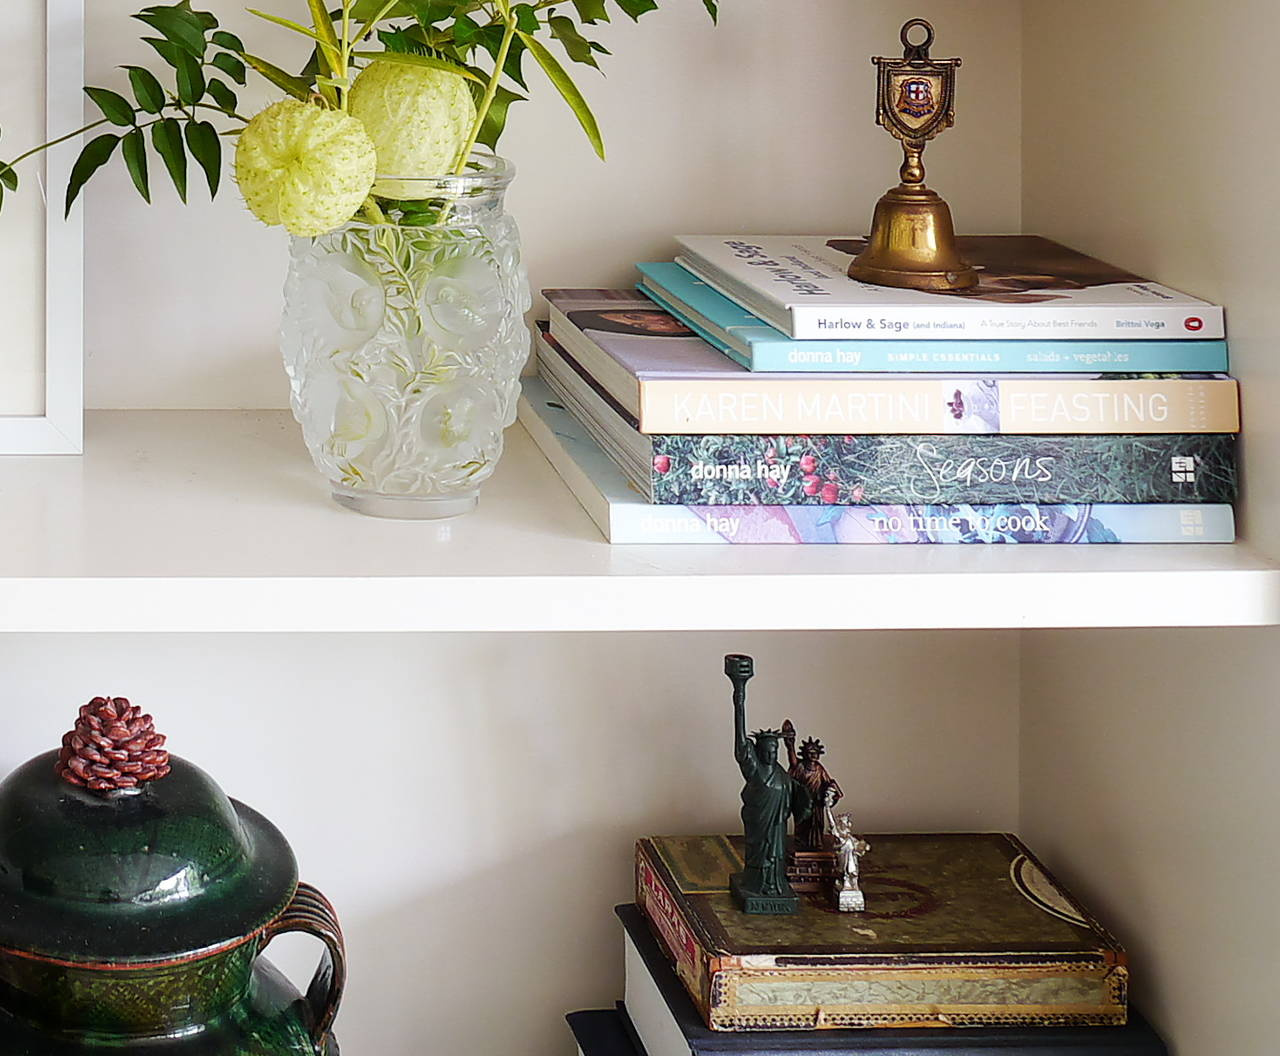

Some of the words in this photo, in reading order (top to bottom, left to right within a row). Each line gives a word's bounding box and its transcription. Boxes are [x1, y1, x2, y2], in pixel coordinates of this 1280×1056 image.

[817, 318, 861, 330] Harlow
[866, 319, 876, 330] &
[879, 319, 910, 332] Sage
[932, 320, 966, 331] Indiana)
[788, 348, 833, 364] donna
[836, 348, 862, 366] hay
[673, 392, 784, 422] KAREN
[799, 392, 930, 422] MARTINI
[1009, 392, 1169, 422] FEASTING
[690, 461, 752, 480] donna
[756, 459, 792, 485] hay
[910, 442, 1056, 500] Seasons
[640, 515, 703, 532] donna
[705, 513, 741, 536] hay
[870, 516, 902, 532] no
[908, 511, 962, 532] time
[968, 514, 990, 532] to
[995, 513, 1050, 533] cook
